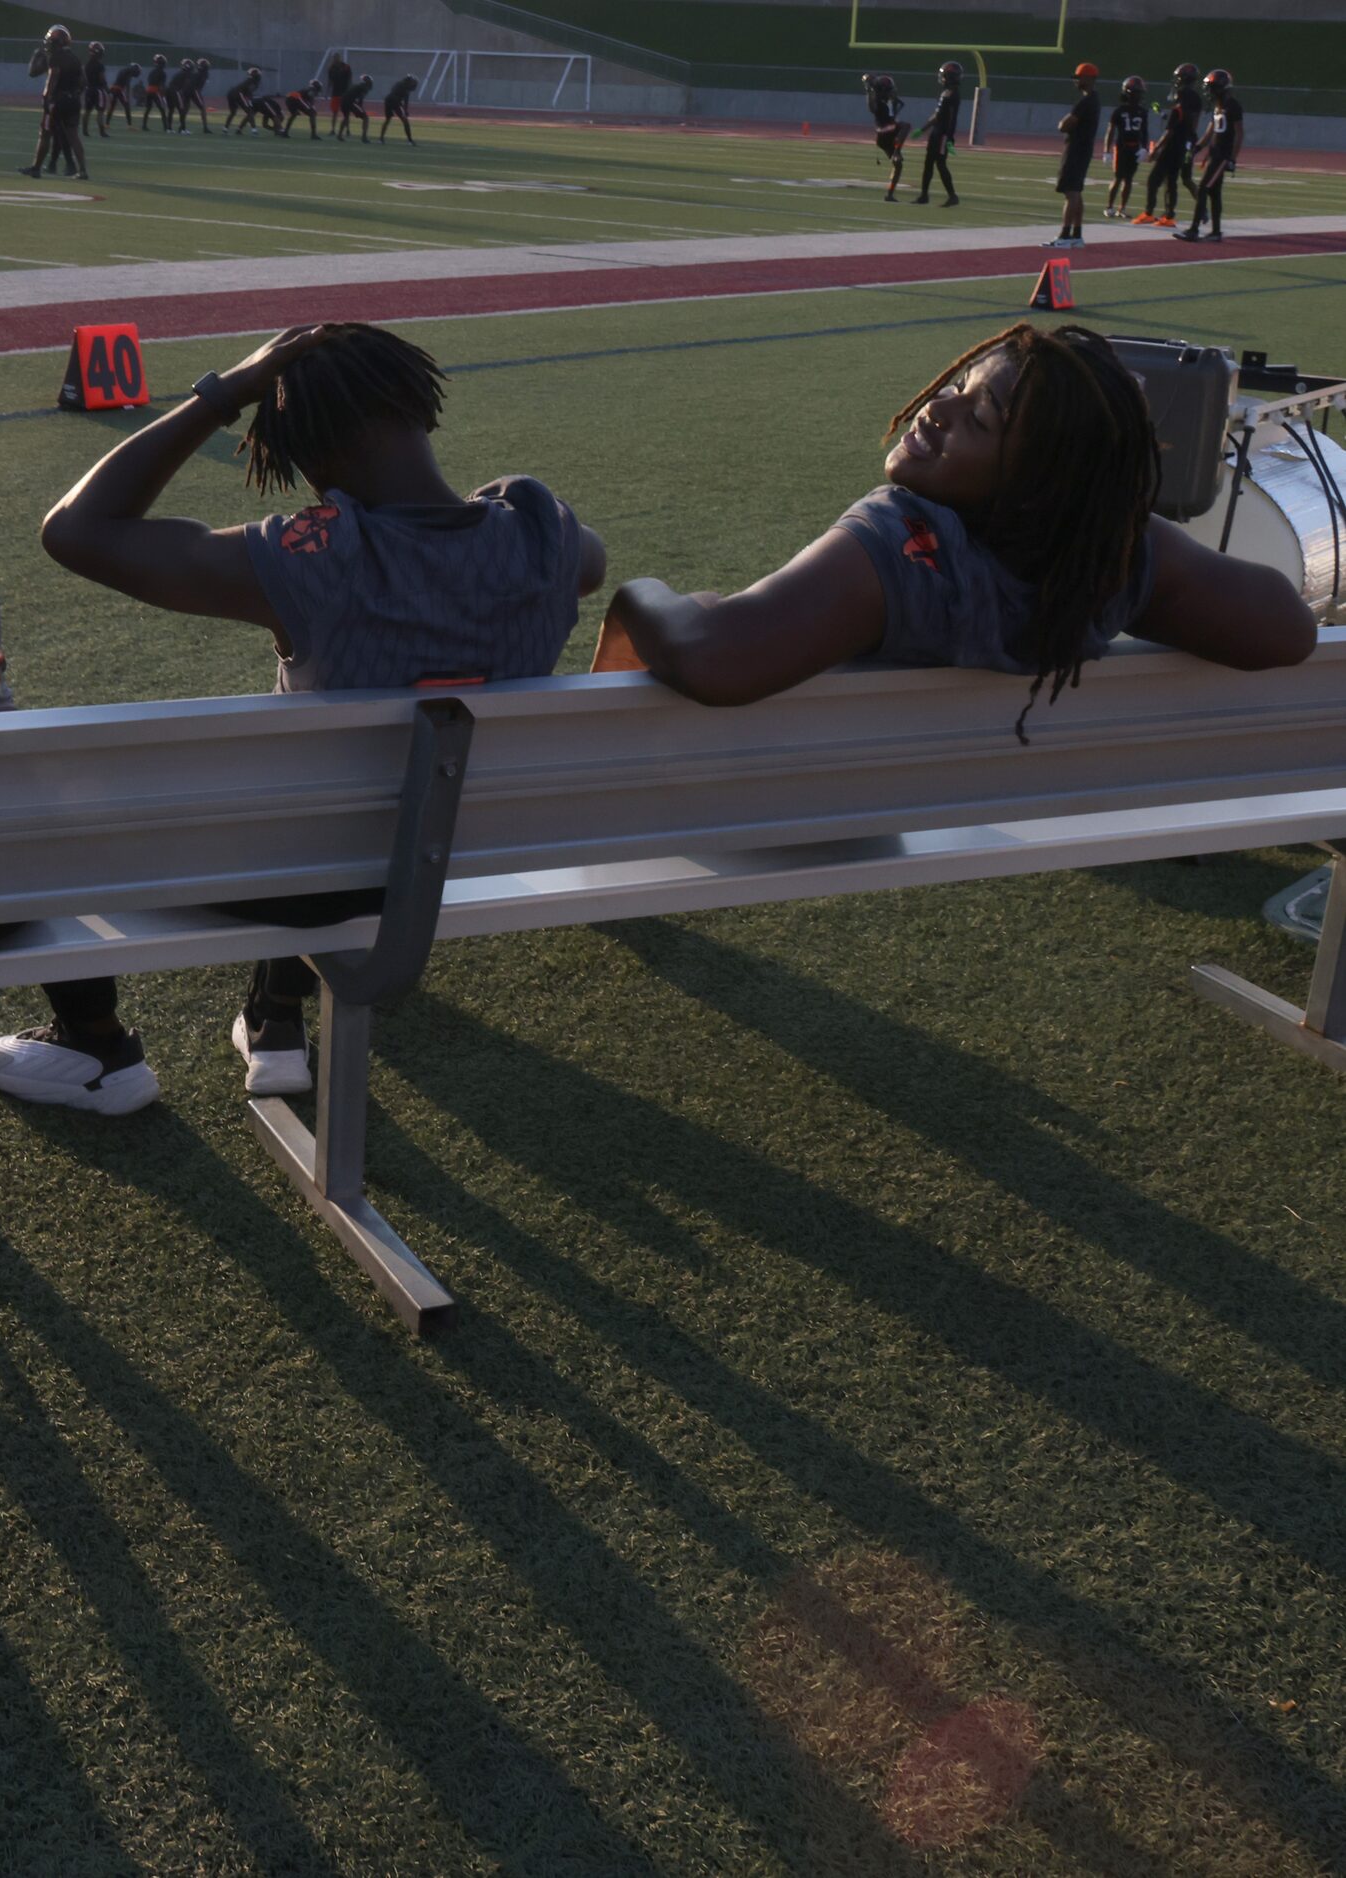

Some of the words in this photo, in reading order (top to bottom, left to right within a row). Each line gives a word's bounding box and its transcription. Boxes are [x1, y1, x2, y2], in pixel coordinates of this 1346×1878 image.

[1121, 111, 1143, 131] 13
[1054, 265, 1072, 304] 50
[87, 334, 142, 401] 40
